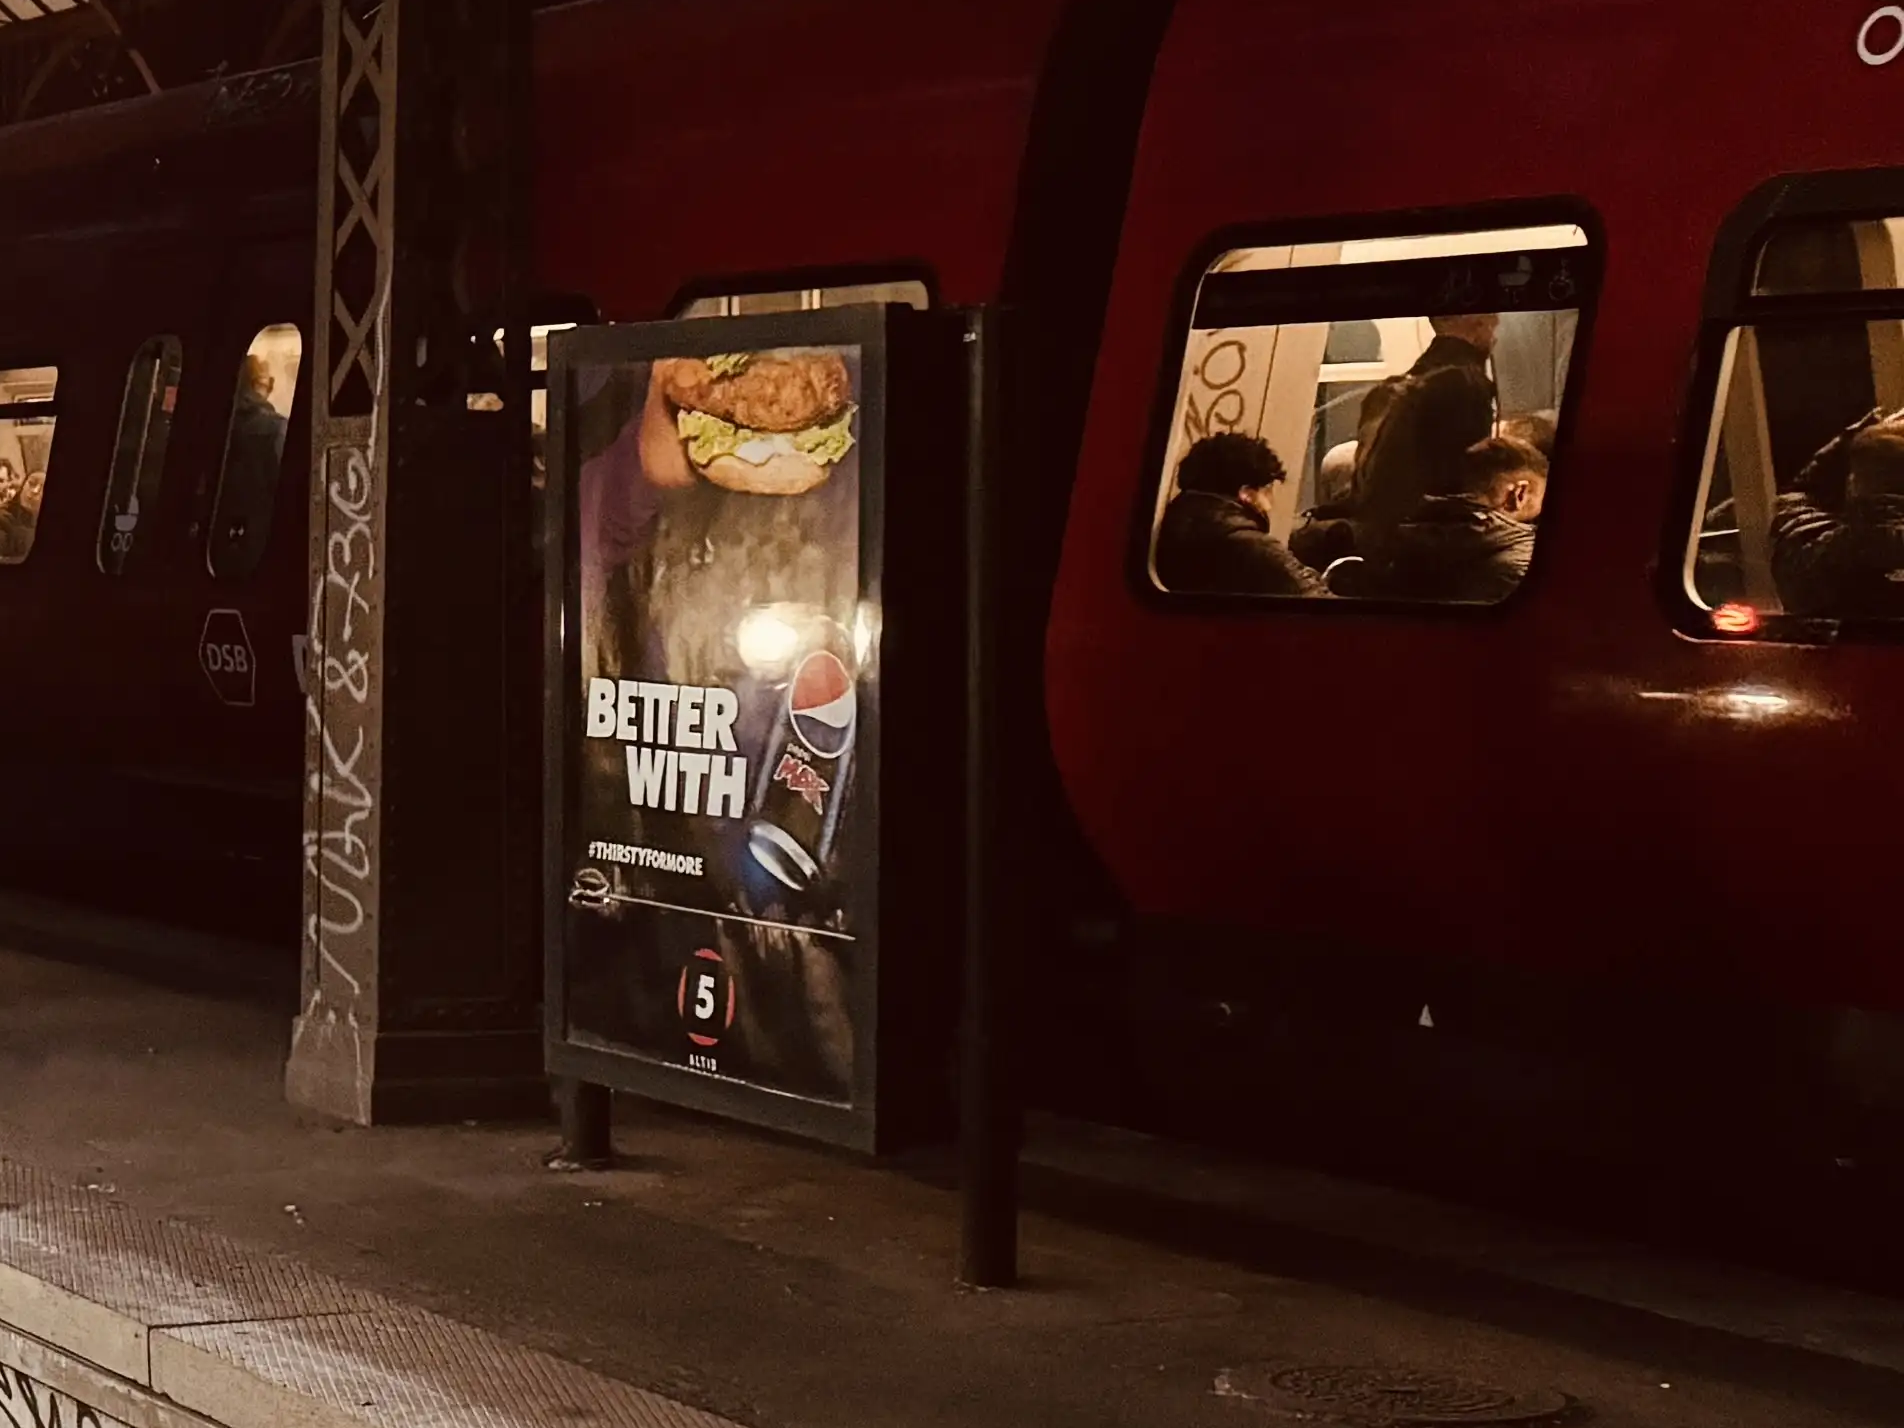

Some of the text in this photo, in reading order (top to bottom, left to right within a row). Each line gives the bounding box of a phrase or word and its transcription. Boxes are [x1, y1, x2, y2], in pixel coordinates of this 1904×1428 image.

[206, 642, 248, 673] DSB
[586, 677, 739, 752] BETTER
[625, 745, 747, 819] WITH
[588, 840, 704, 876] #THIRSTYFORMORE
[695, 974, 714, 1019] 5
